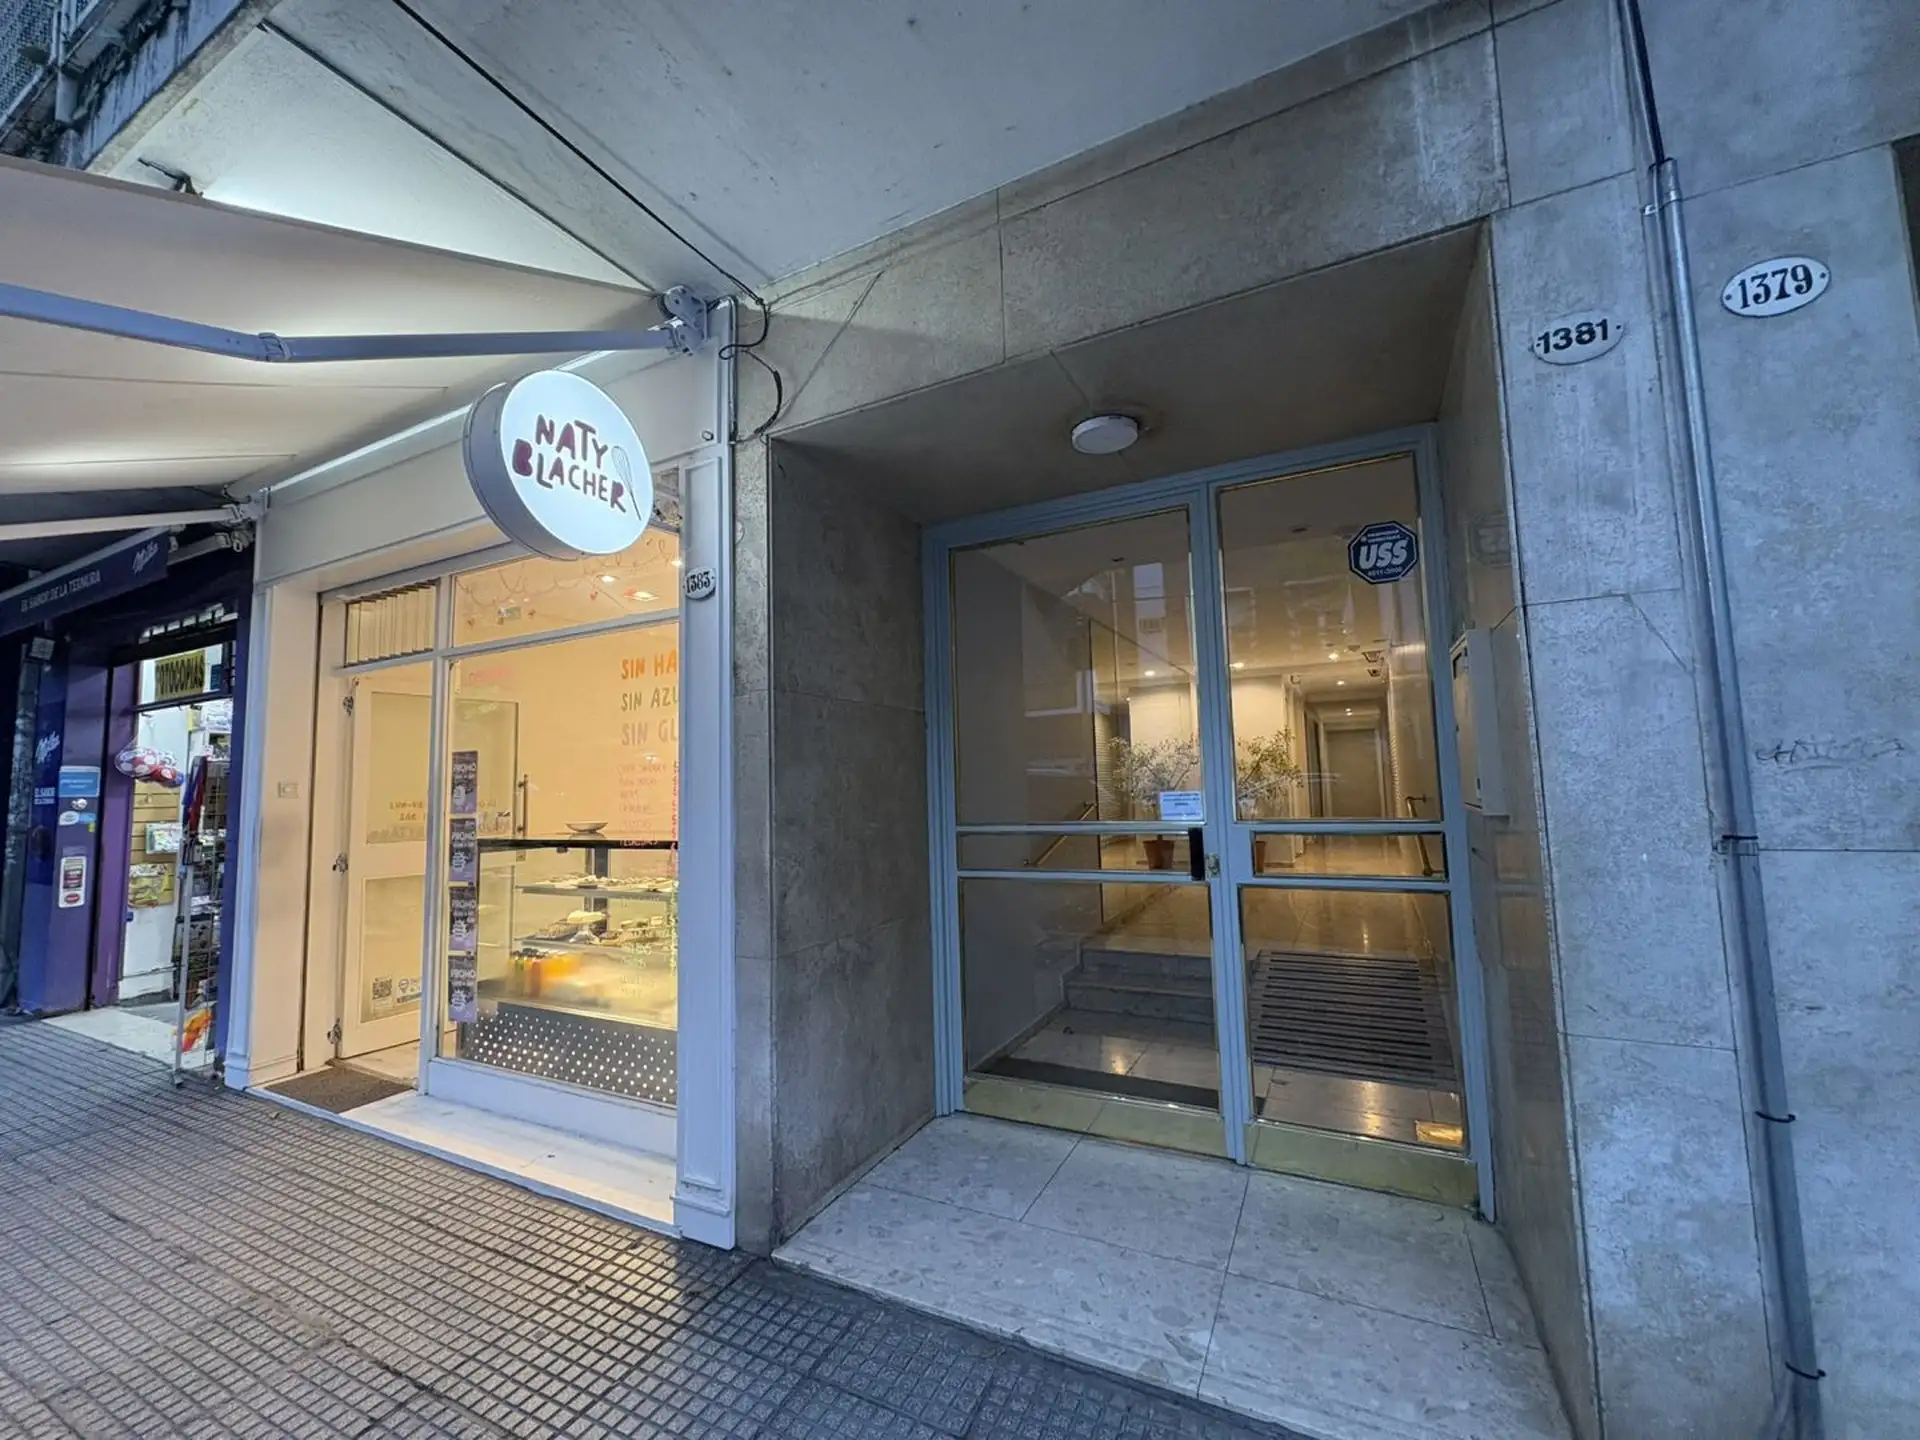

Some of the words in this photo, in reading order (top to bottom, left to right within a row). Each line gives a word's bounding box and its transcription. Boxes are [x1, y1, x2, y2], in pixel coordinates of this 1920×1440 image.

[1738, 264, 1813, 309] 1379
[1538, 318, 1608, 353] 1381
[535, 414, 608, 469] NATY
[512, 439, 626, 513] BLACHER
[1359, 540, 1409, 569] USS
[59, 583, 69, 597] LA
[686, 571, 711, 593] 1383
[155, 655, 205, 696] FOTOCOPIAS
[621, 657, 646, 679] SIN
[621, 691, 642, 712] SIN
[621, 721, 648, 746] SIN
